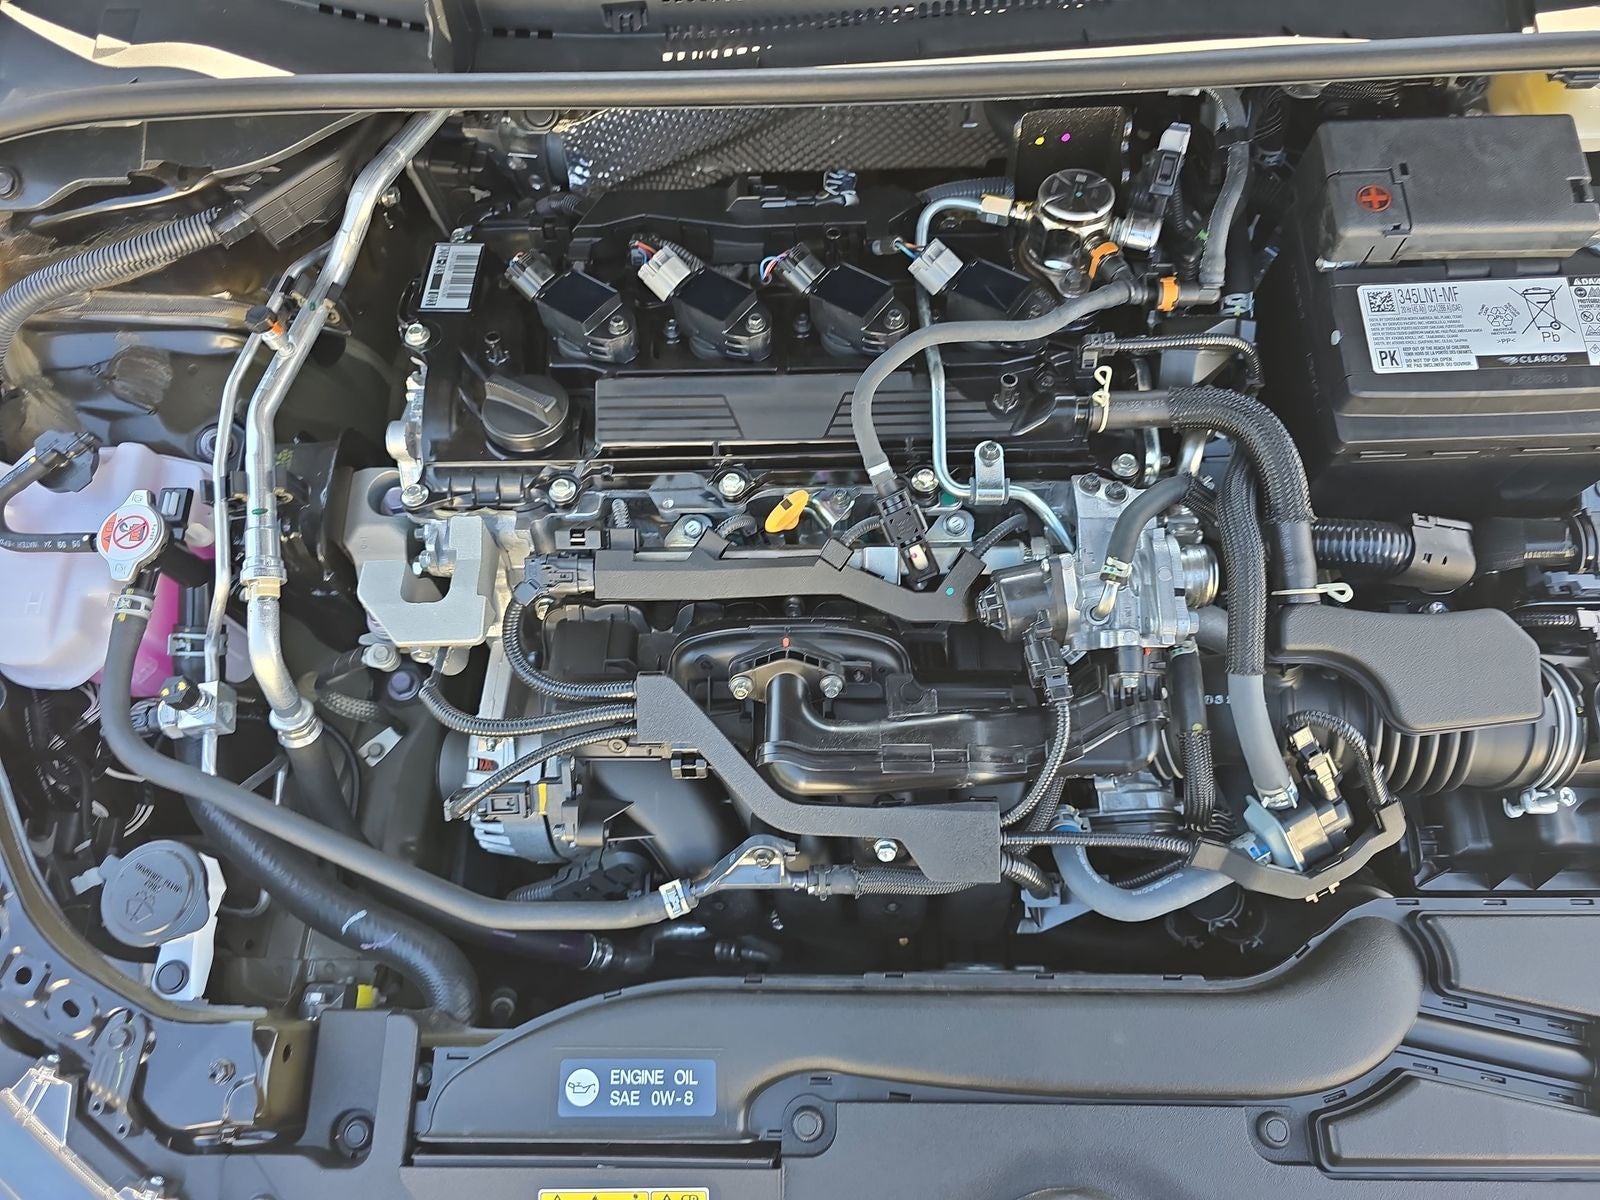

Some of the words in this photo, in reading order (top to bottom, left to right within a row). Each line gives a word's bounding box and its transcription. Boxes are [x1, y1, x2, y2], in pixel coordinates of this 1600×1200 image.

[1398, 286, 1458, 304] 345LN1-MF
[1542, 330, 1560, 342] Pb
[1378, 350, 1399, 366] PK
[1519, 354, 1568, 364] CLARIOS
[610, 1070, 664, 1085] ENGINE
[674, 1070, 698, 1085] OIL
[610, 1090, 640, 1106] SAE
[651, 1090, 694, 1106] 0W-8
